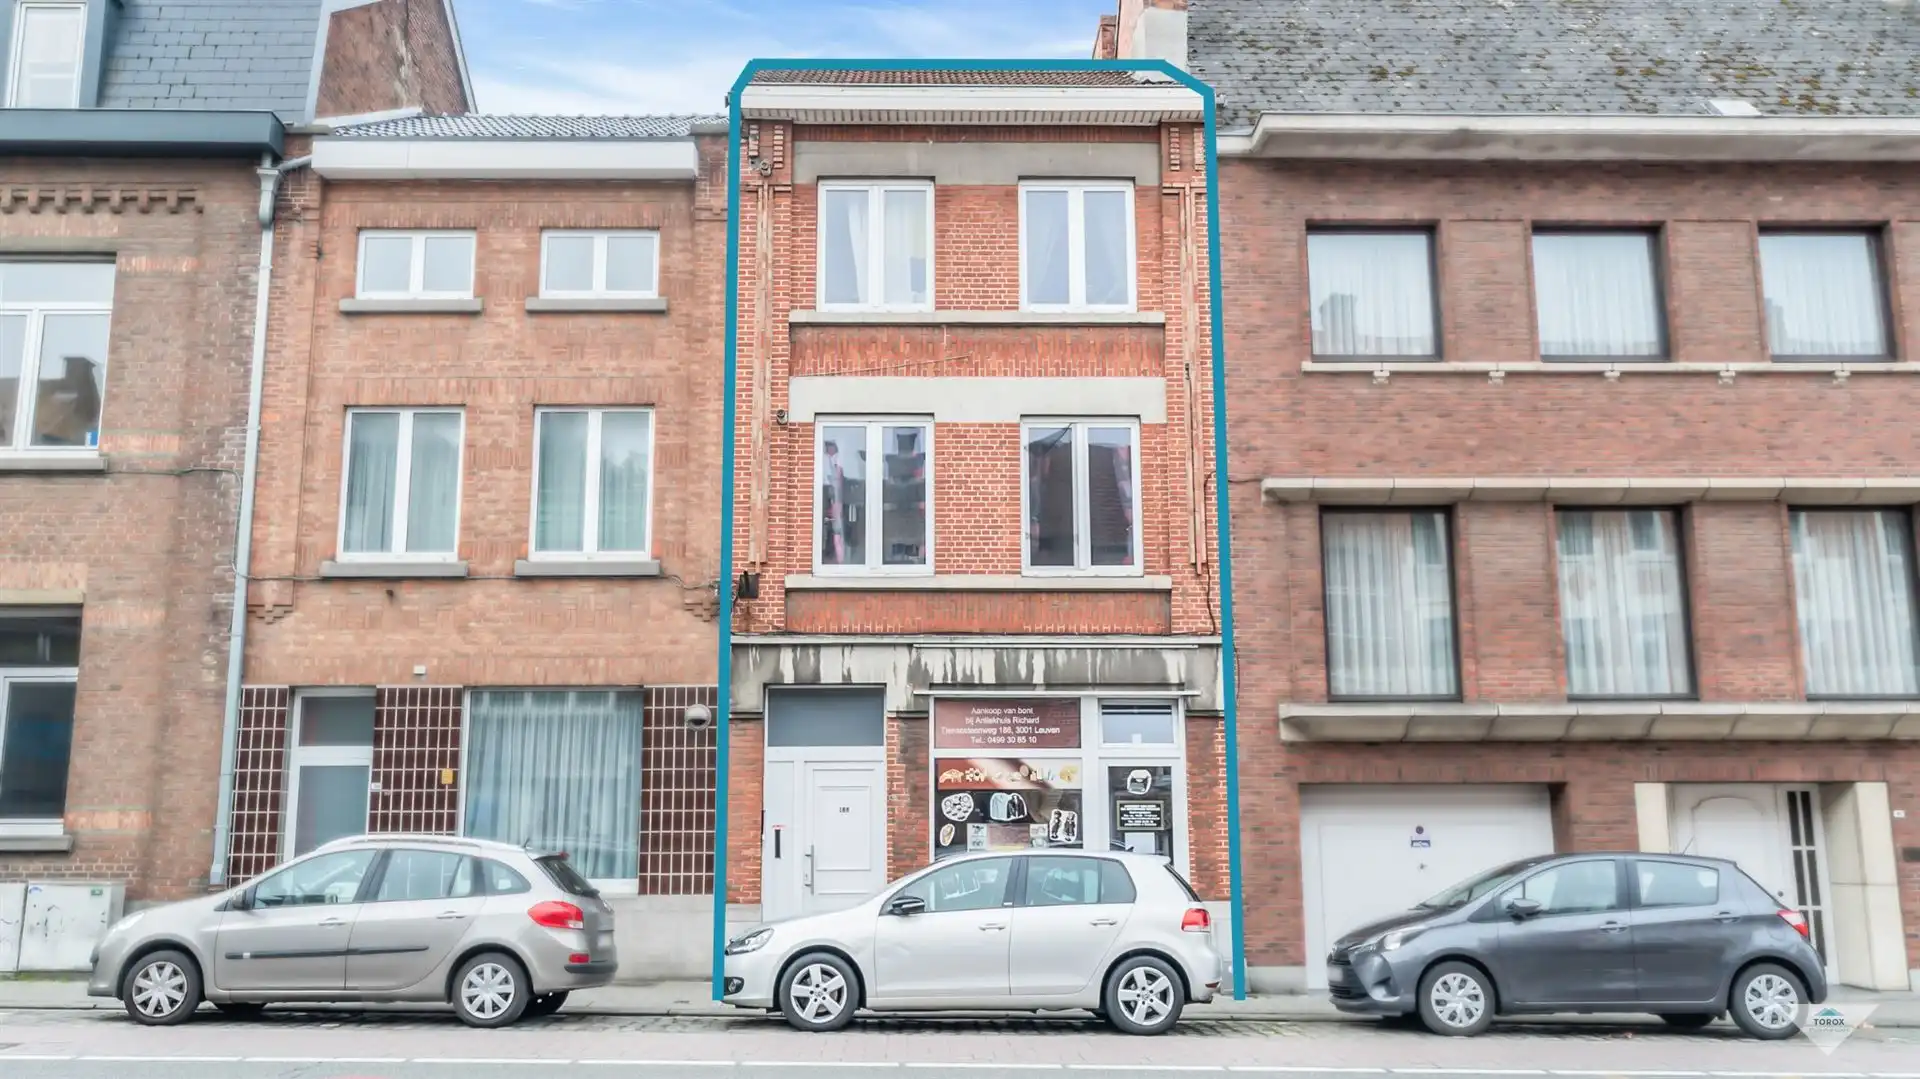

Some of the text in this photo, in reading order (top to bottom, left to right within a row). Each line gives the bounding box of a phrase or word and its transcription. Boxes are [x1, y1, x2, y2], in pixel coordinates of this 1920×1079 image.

[971, 707, 1001, 716] Aankoop
[965, 716, 974, 726] bij
[1012, 716, 1040, 724] Richard
[1015, 726, 1032, 734] 3001
[1034, 726, 1060, 734] Leuven
[987, 736, 1006, 744] 0499
[1006, 736, 1016, 744] 30
[1028, 736, 1037, 744] 10
